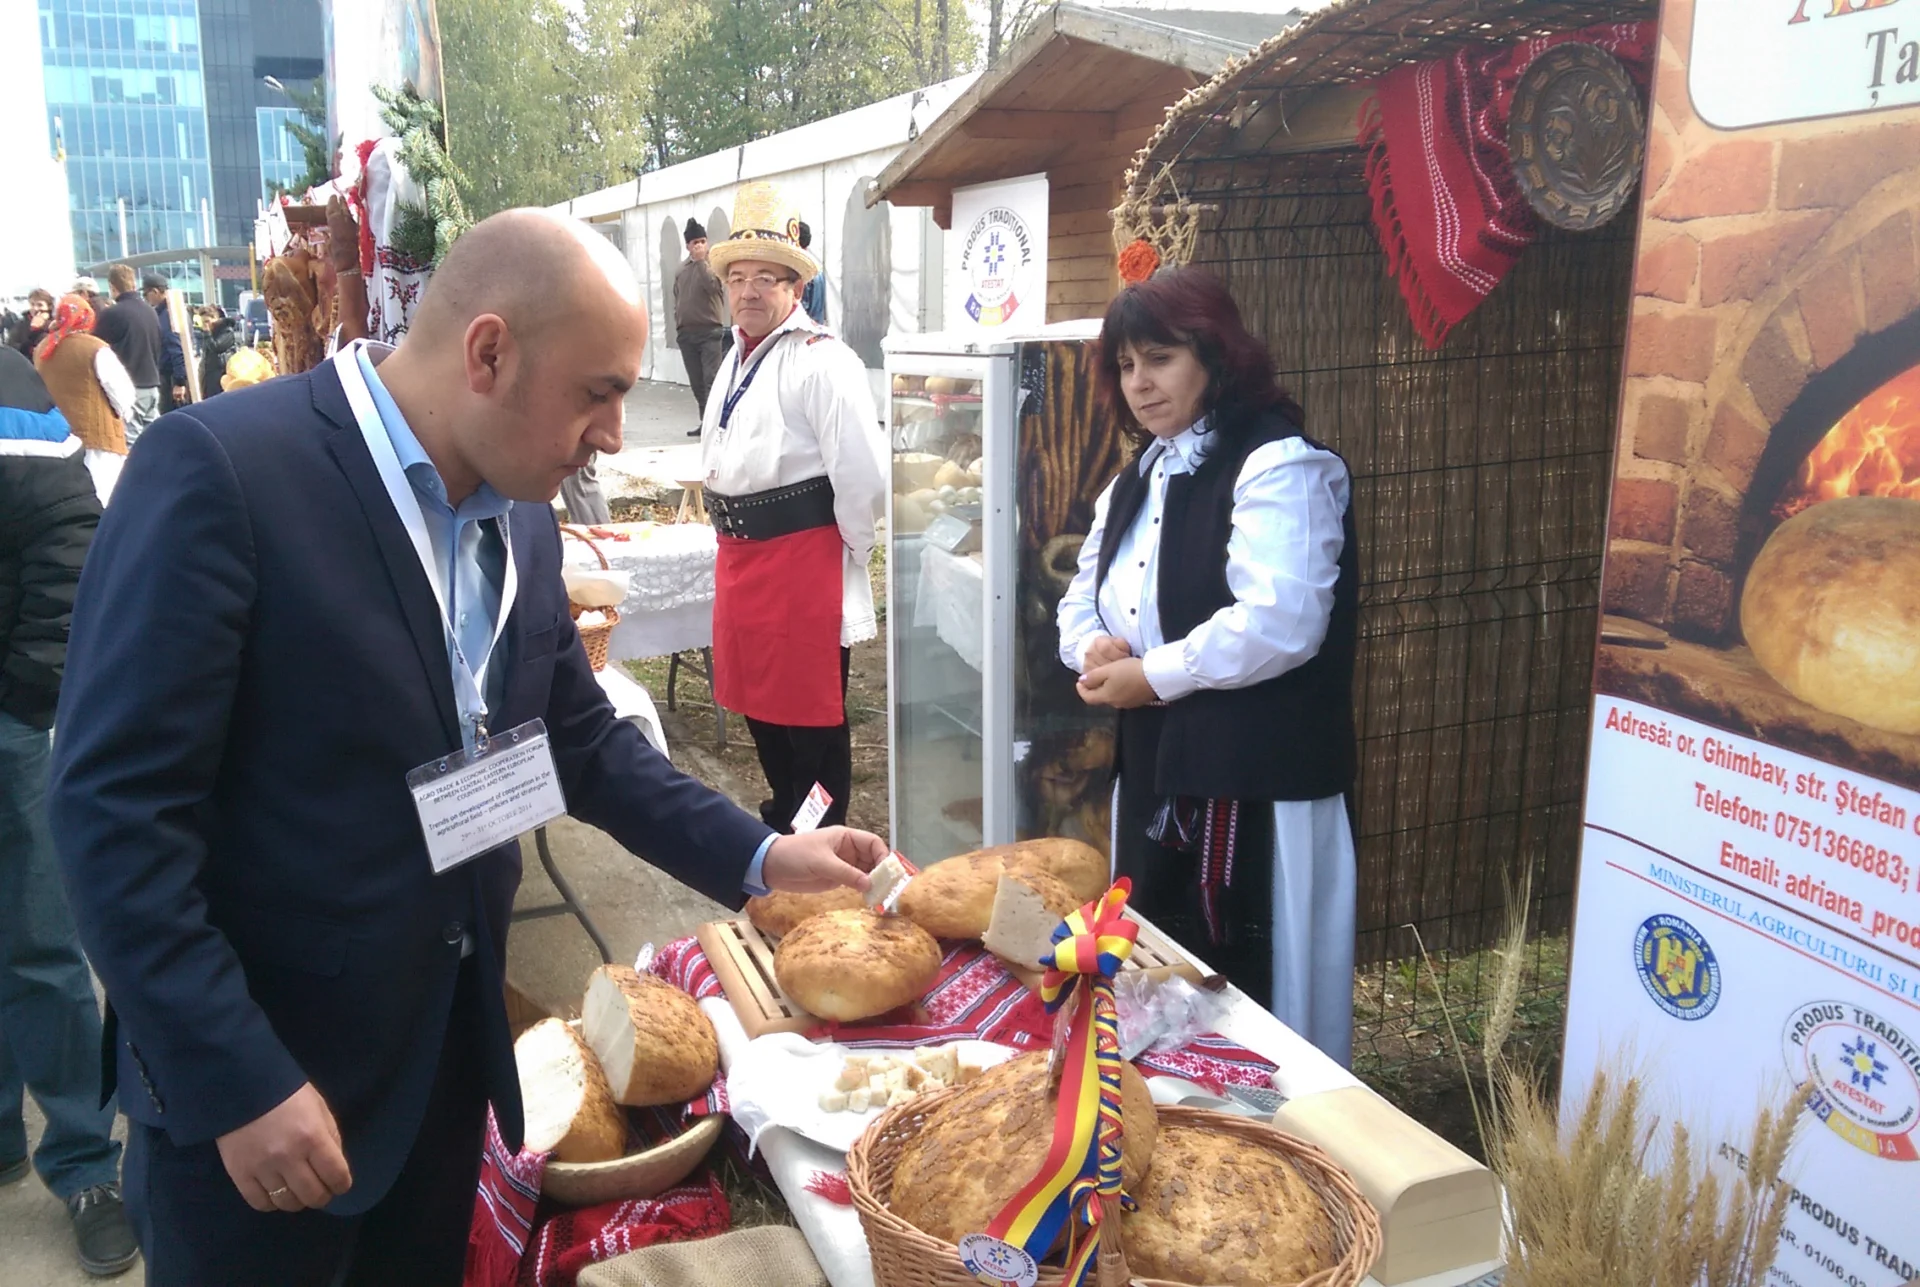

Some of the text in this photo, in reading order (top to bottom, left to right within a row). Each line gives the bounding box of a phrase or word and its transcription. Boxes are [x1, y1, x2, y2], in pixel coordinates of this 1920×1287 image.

[962, 217, 986, 271] PRODUS
[419, 790, 436, 802] AGRO
[436, 782, 454, 794] TRADE
[460, 767, 487, 783] ECONOMIC
[488, 749, 526, 771] COOPERATION
[525, 741, 545, 754] FORUM
[433, 787, 460, 804] BETWEEN
[506, 753, 535, 770] EUROPEAN
[1605, 707, 1672, 748] Adresă:
[1677, 733, 1697, 757] or.
[1702, 737, 1788, 794] Ghimbav,
[1795, 771, 1827, 802] str.
[428, 816, 450, 831] Trends
[458, 795, 496, 818] development
[501, 777, 535, 798] cooperation
[540, 768, 551, 779] the
[436, 816, 471, 837] agricultural
[469, 810, 483, 820] field
[487, 798, 510, 813] policies
[508, 792, 522, 802] and
[520, 780, 549, 798] strategies
[456, 769, 516, 801] COUNTRIES AND CHINA
[1694, 782, 1910, 893] Telefon: 0751366883;
[1719, 841, 1780, 888] Email:
[1649, 863, 1746, 919] MINISTERUL
[1749, 911, 1883, 982] AGRICULTURII
[1791, 1005, 1844, 1046] PRODUS
[1833, 1079, 1886, 1115] ATESTAT
[1790, 1188, 1860, 1246] PRODUS
